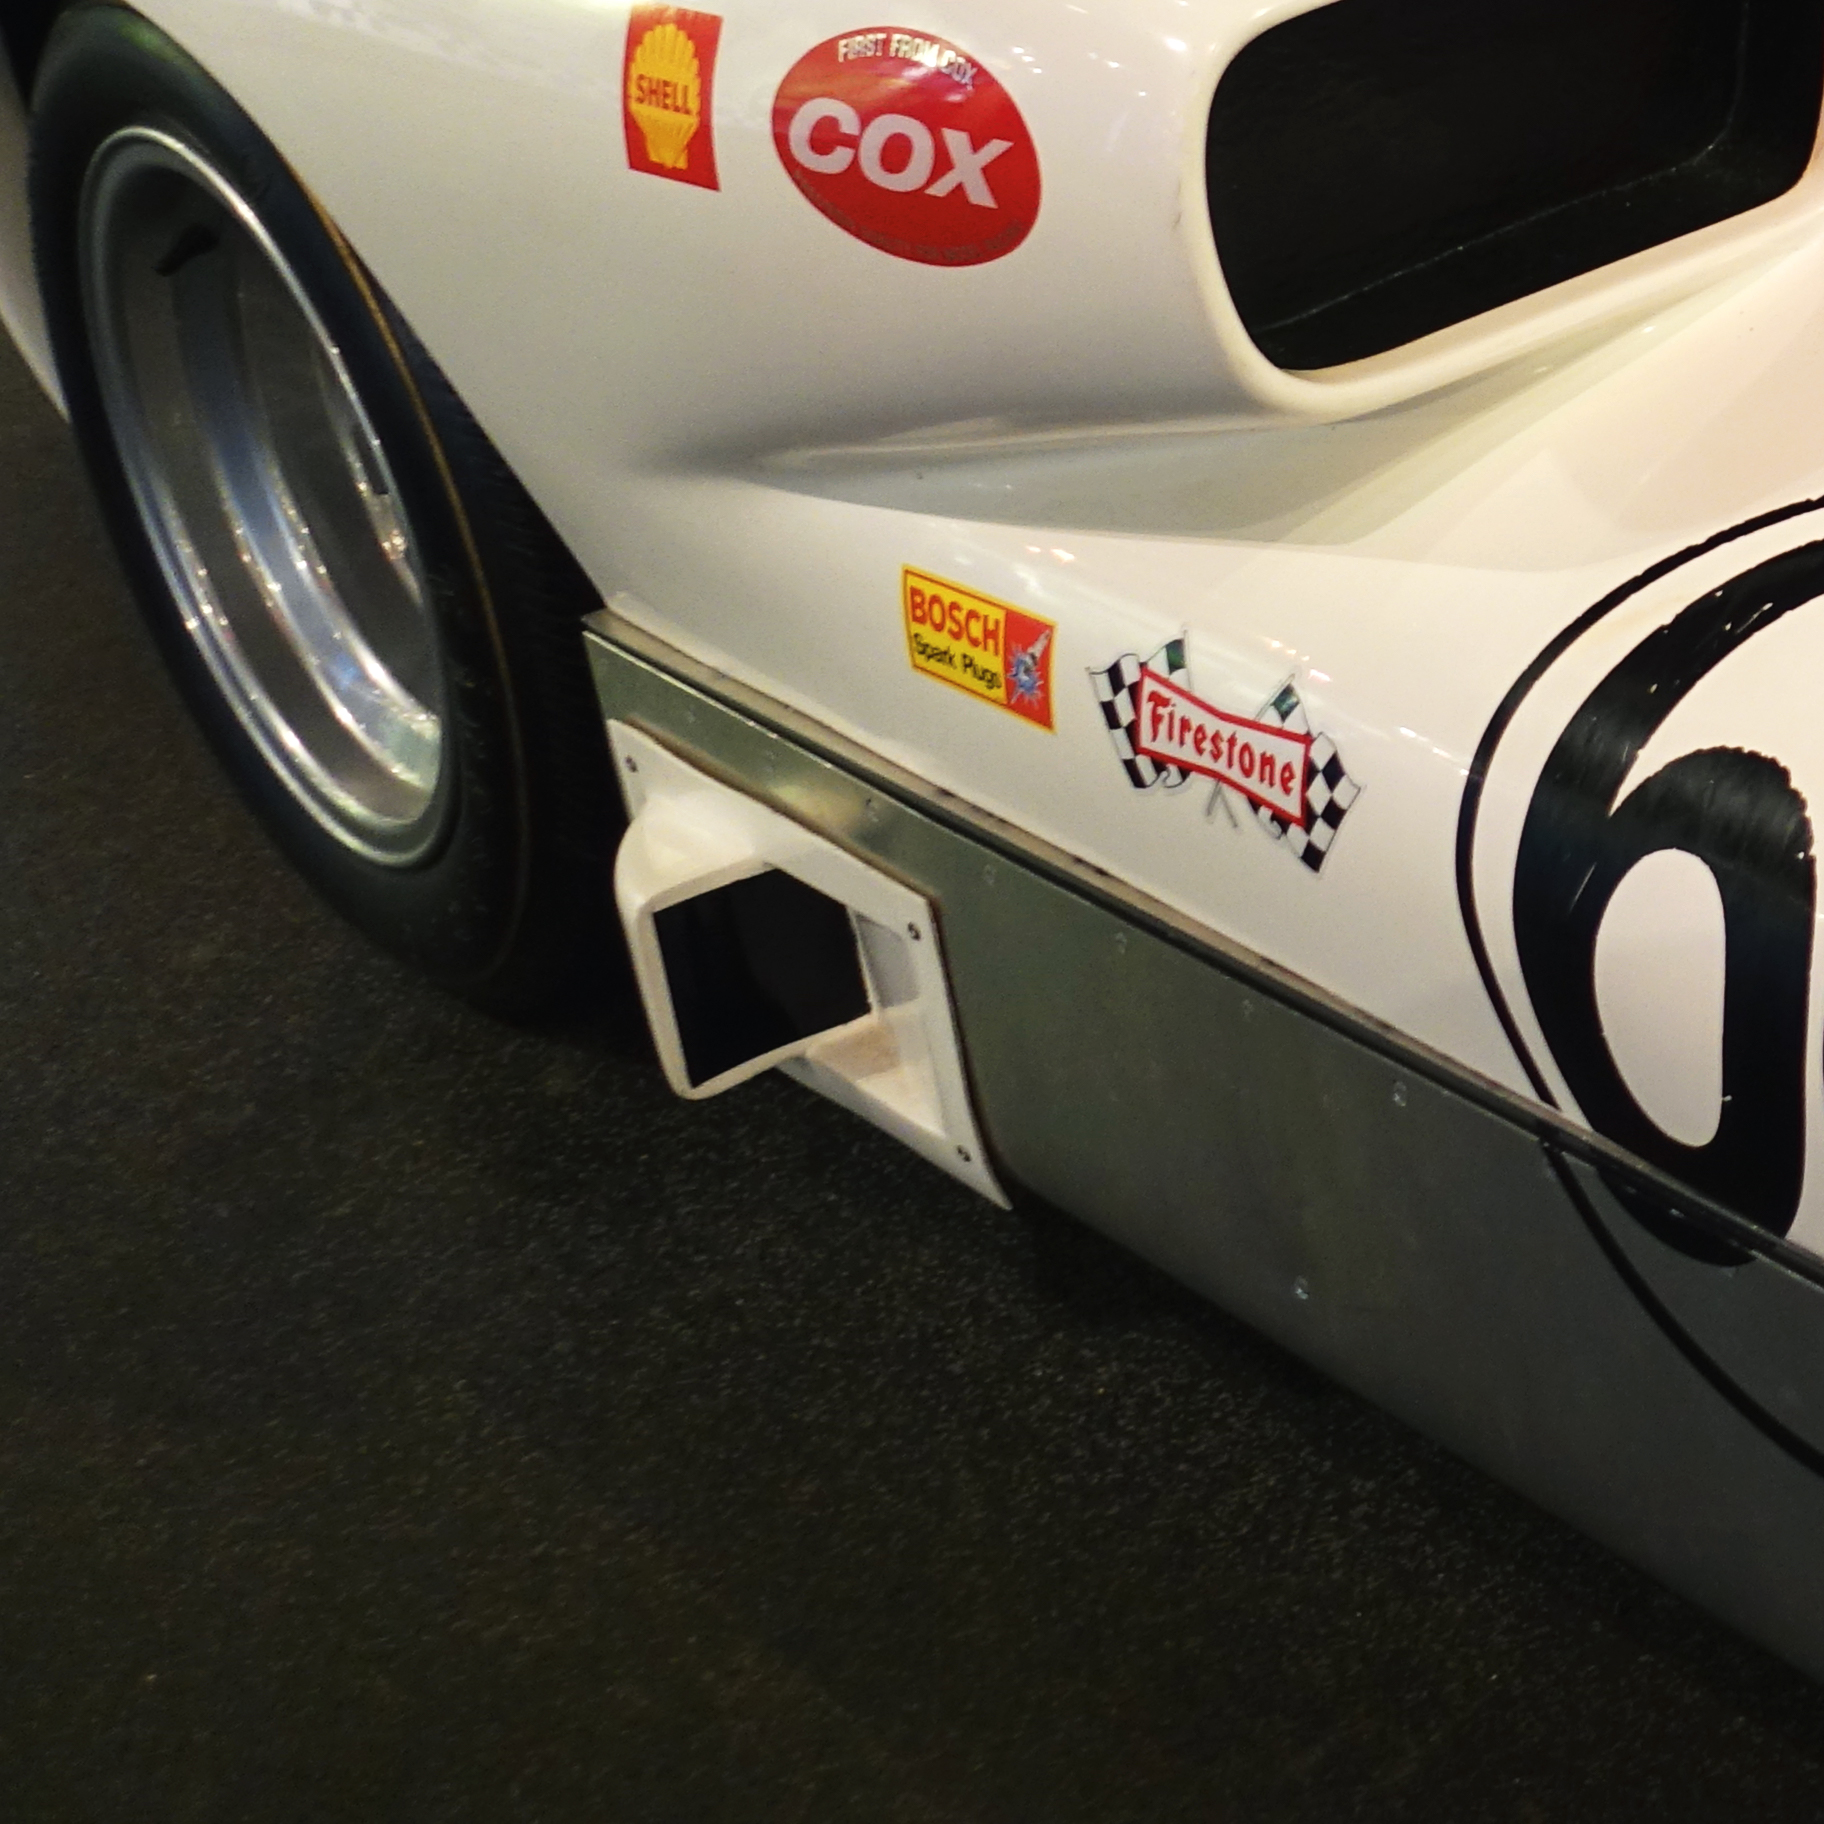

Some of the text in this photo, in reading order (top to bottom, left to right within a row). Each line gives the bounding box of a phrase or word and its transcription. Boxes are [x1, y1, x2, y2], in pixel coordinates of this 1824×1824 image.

[635, 73, 691, 116] SHELL
[788, 96, 1014, 209] COX
[909, 585, 999, 656] BOSCH
[913, 633, 1002, 690] Spark Plugs
[1146, 688, 1297, 799] Firestone
